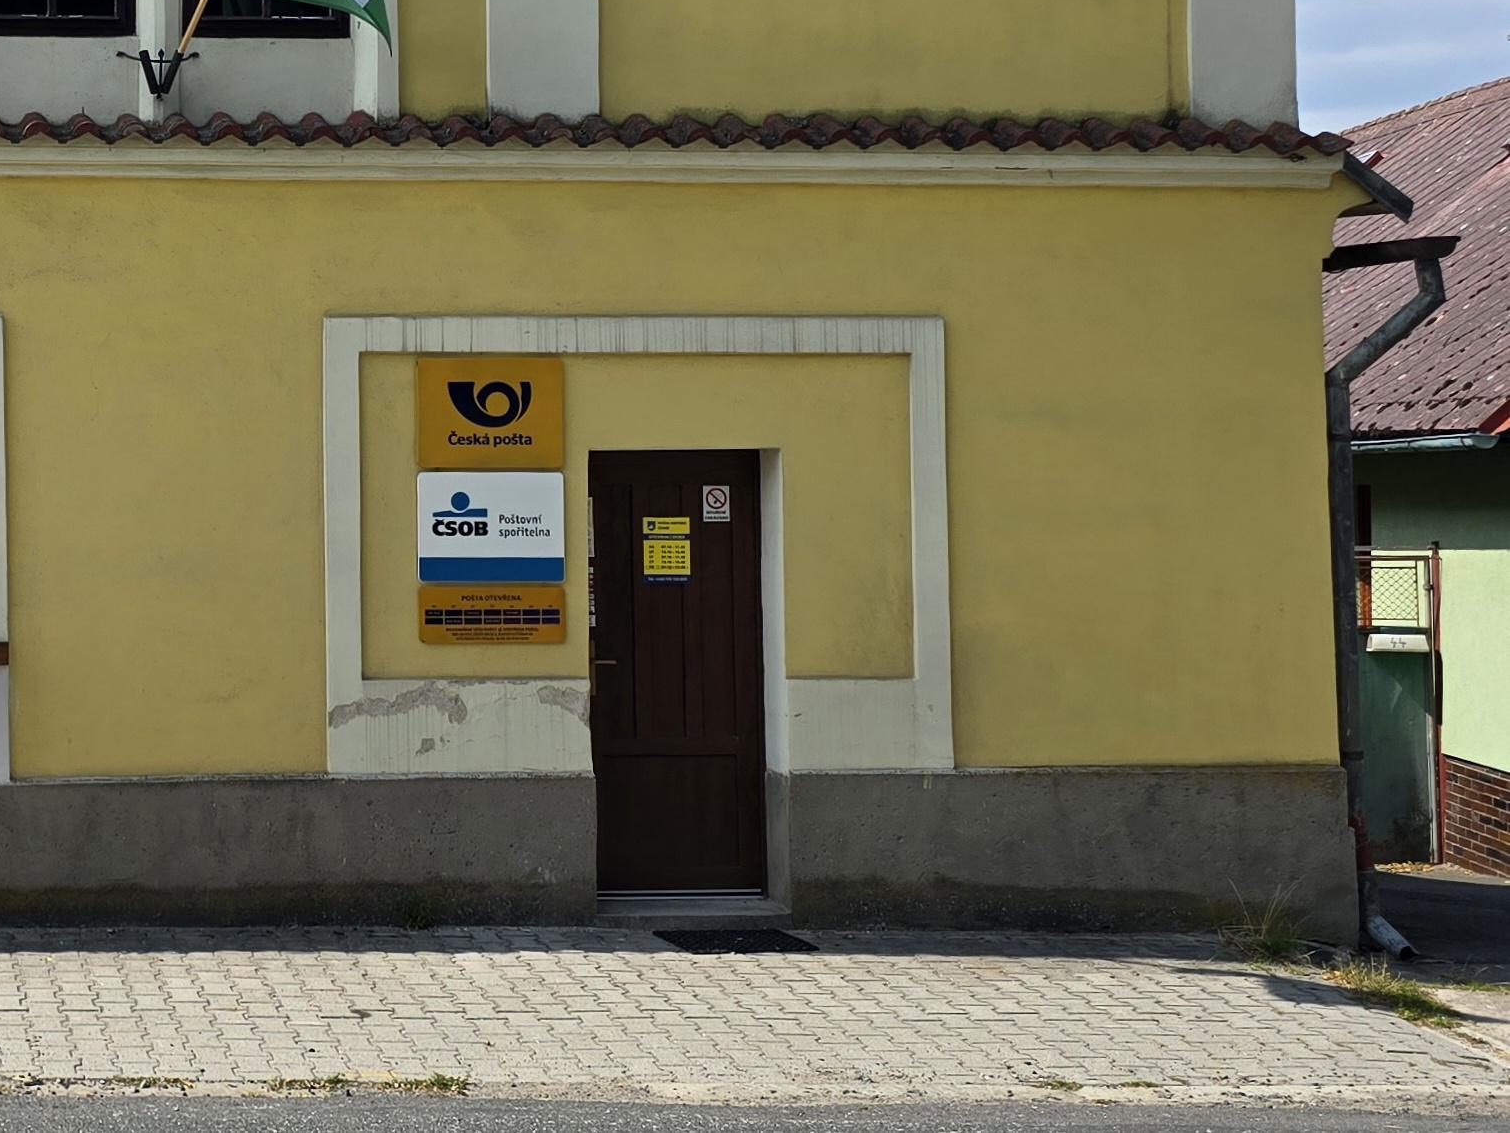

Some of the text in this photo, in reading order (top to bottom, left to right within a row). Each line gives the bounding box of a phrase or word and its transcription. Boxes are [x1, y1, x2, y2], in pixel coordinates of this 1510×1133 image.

[447, 430, 533, 448] Česká pošta
[498, 514, 543, 525] Poštovní
[432, 518, 489, 536] ČSOB
[498, 526, 551, 539] spořitelna
[1390, 637, 1407, 648] 44
